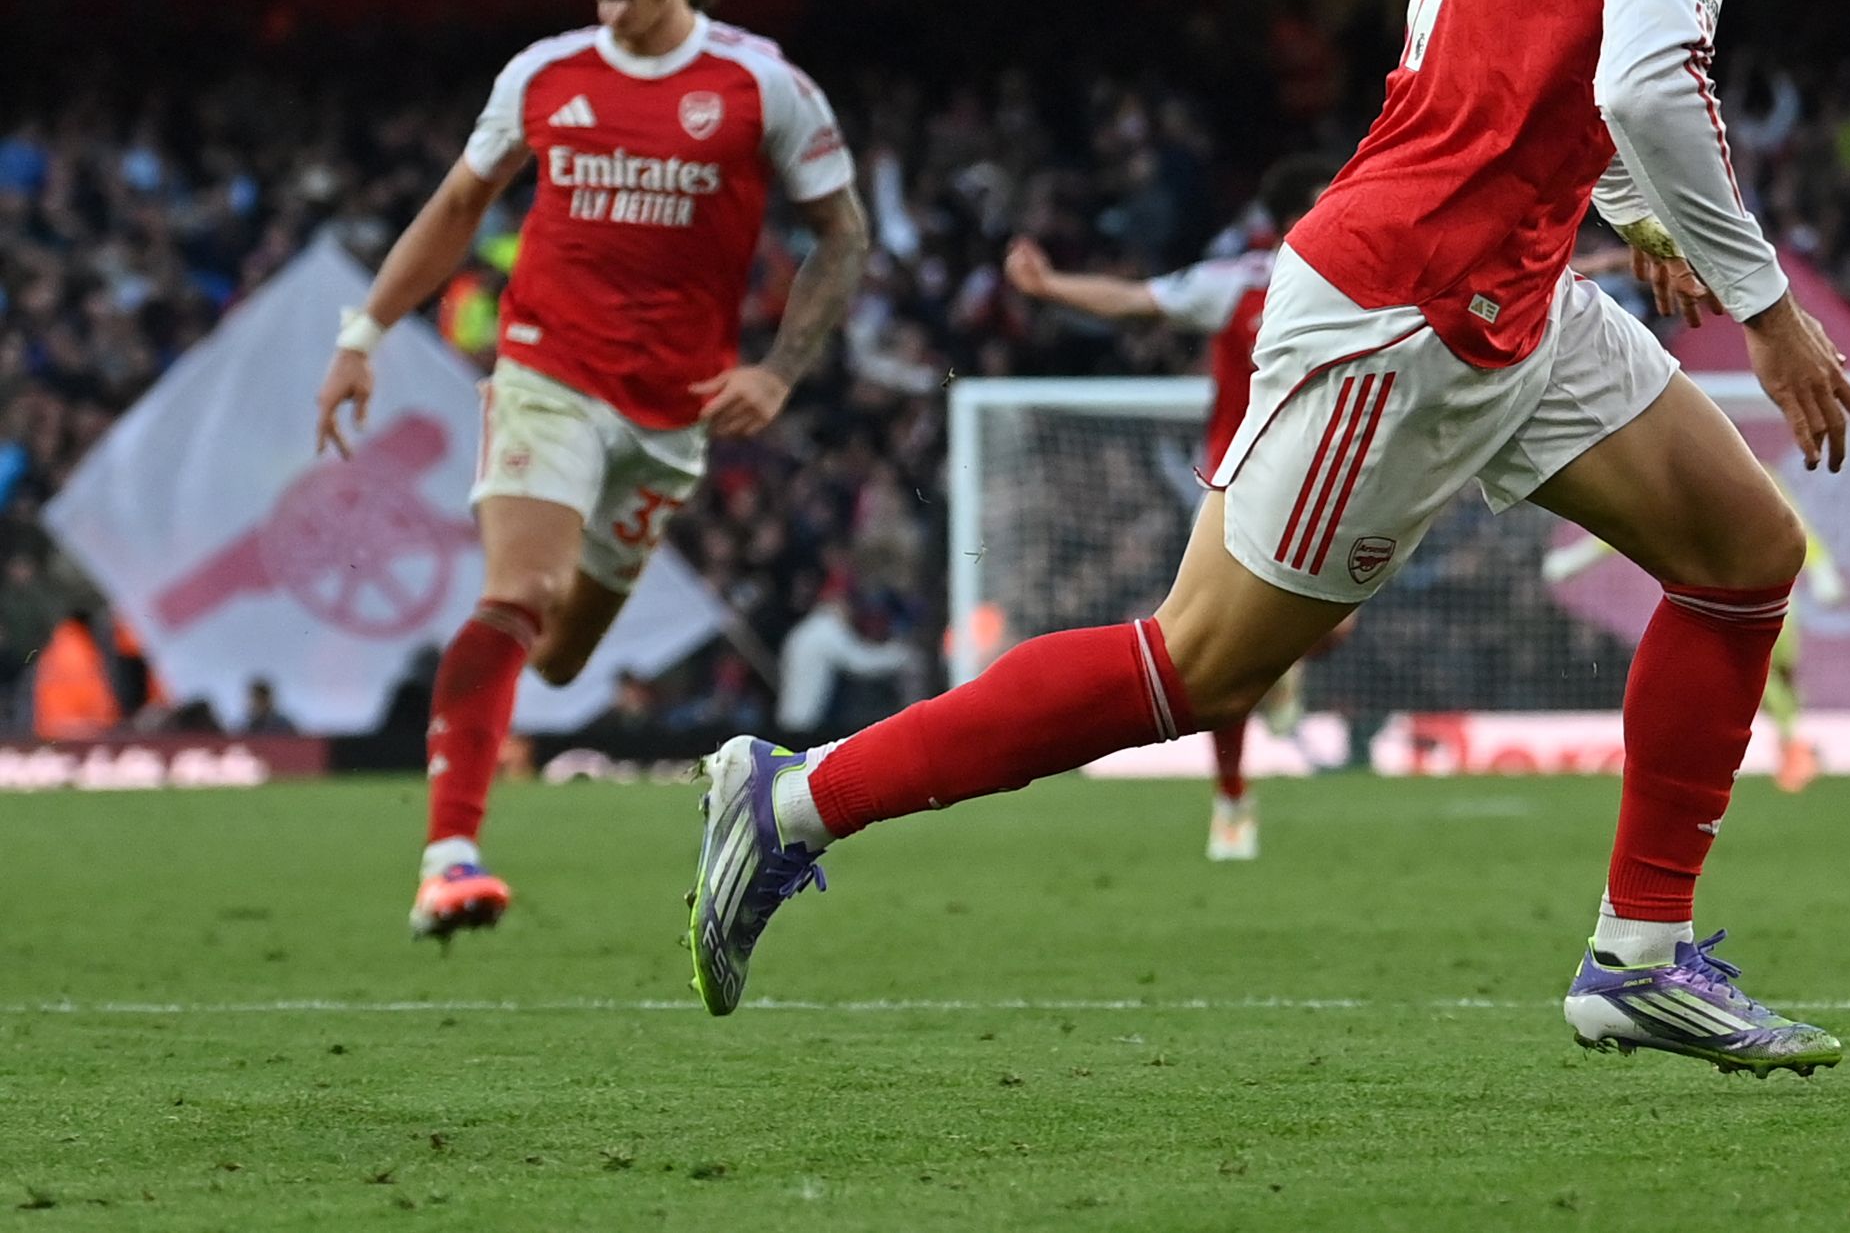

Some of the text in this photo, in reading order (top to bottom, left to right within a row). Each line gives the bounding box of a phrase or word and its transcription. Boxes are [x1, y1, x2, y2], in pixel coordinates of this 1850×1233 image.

[548, 144, 721, 195] Emirates
[569, 188, 695, 228] FLY BETTER
